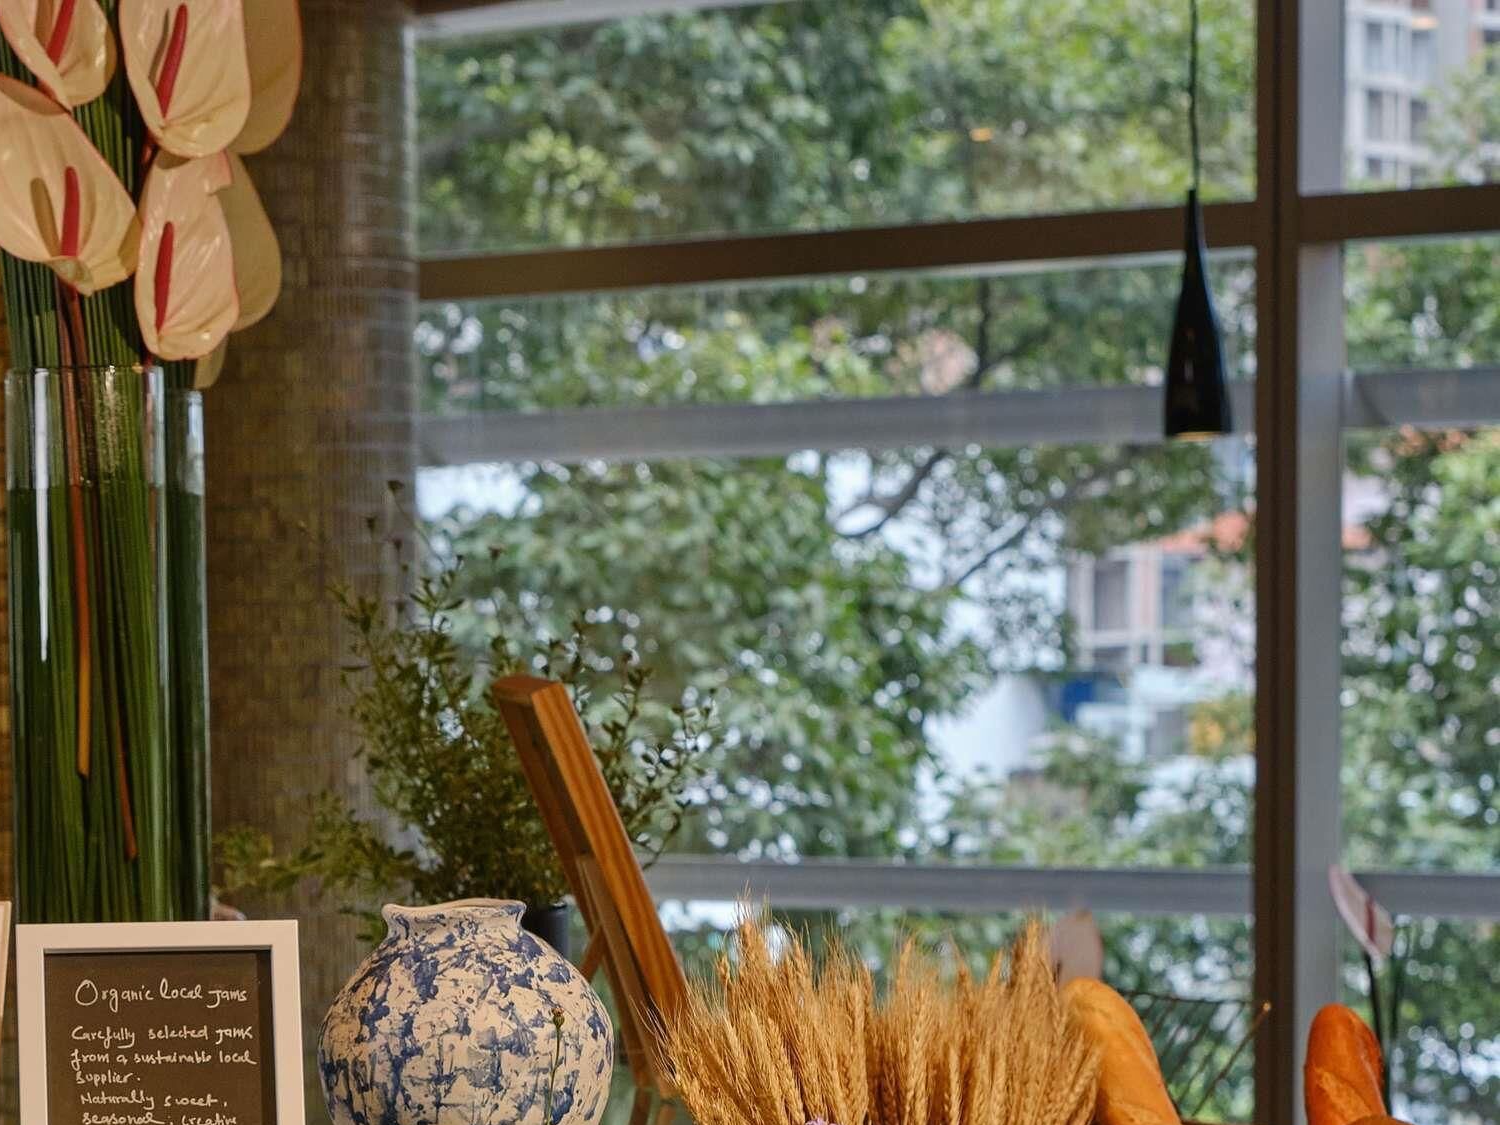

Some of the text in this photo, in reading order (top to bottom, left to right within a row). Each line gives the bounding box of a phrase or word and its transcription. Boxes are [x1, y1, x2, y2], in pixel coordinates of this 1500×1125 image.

[75, 978, 154, 1013] Organic
[159, 977, 203, 1000] local
[71, 1025, 136, 1049] Carefully
[148, 1025, 209, 1041] selected
[70, 1048, 258, 1071] from a sustainable local
[80, 1089, 155, 1110] Naturally
